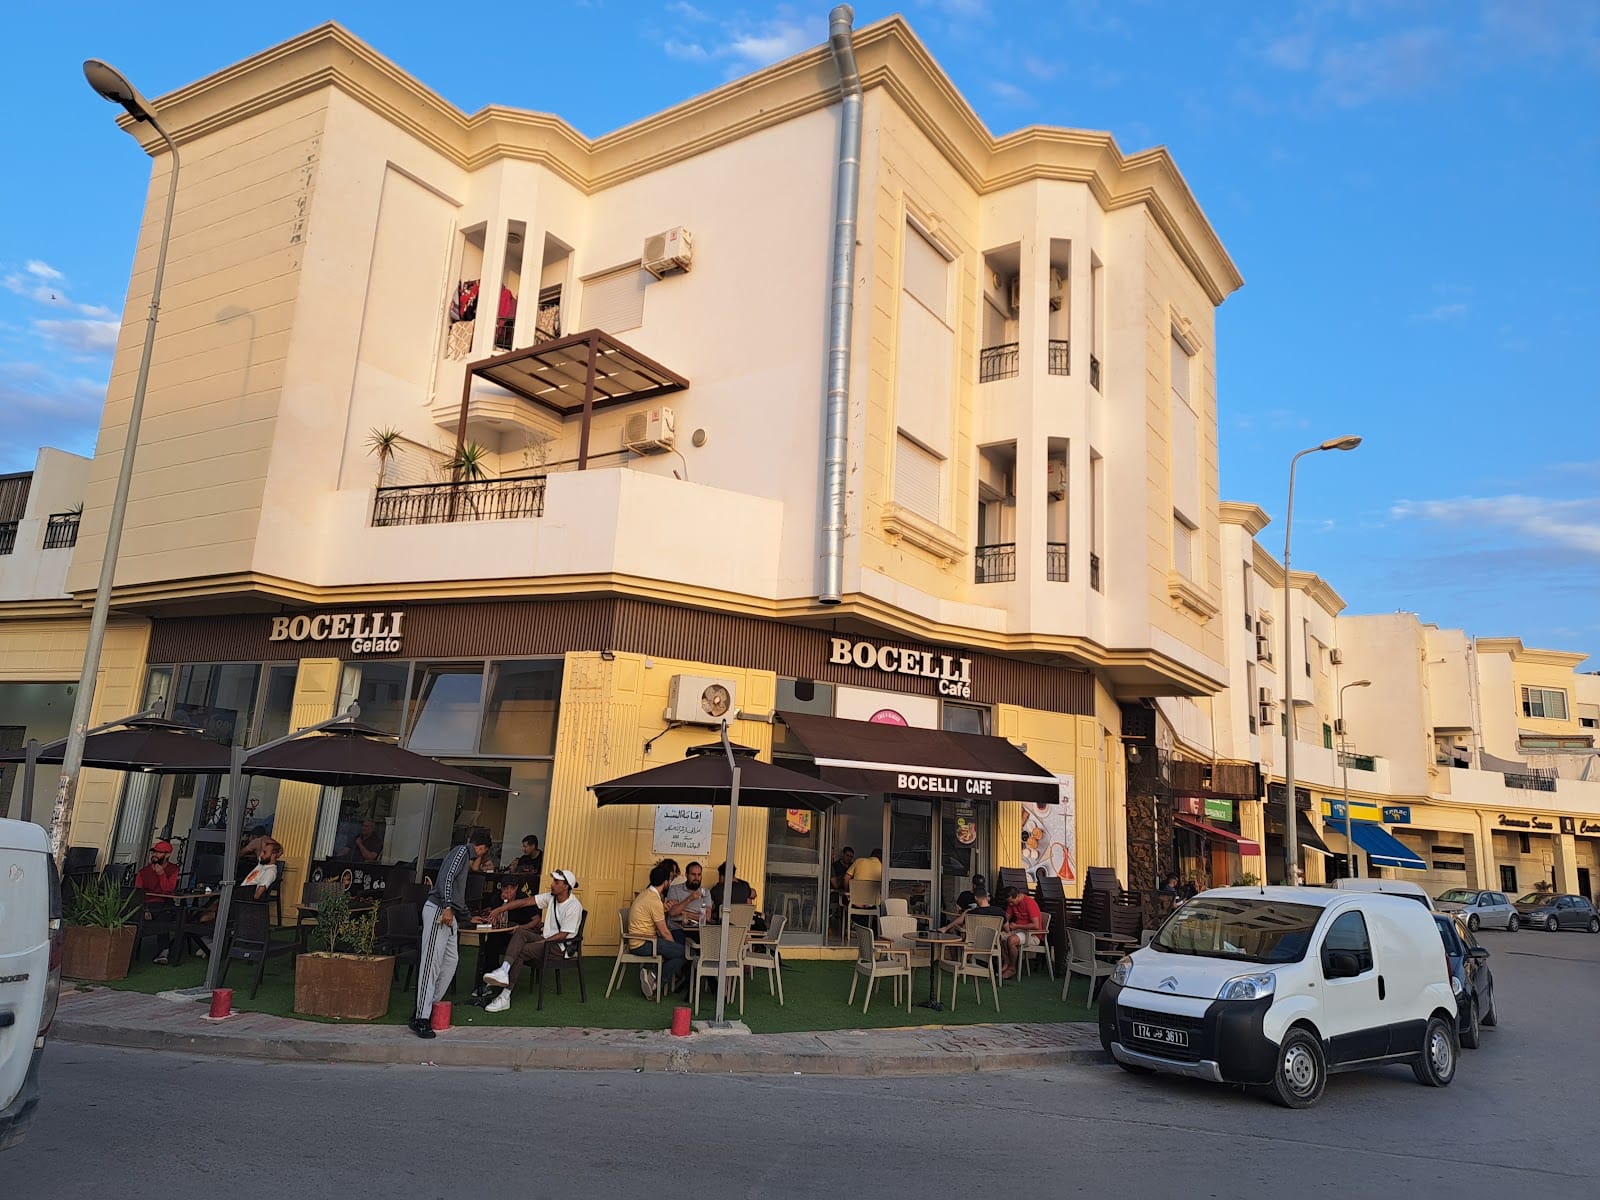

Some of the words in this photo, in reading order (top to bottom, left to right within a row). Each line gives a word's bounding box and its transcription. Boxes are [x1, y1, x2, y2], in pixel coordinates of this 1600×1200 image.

[269, 612, 403, 641] BOCELLI
[351, 638, 400, 653] Gelato
[829, 638, 972, 683] BOCELLI
[939, 679, 971, 698] Café
[897, 773, 958, 793] BOCELLI
[965, 779, 992, 795] CAFE
[1138, 1025, 1151, 1038] 174
[1165, 1030, 1183, 1044] 3611
